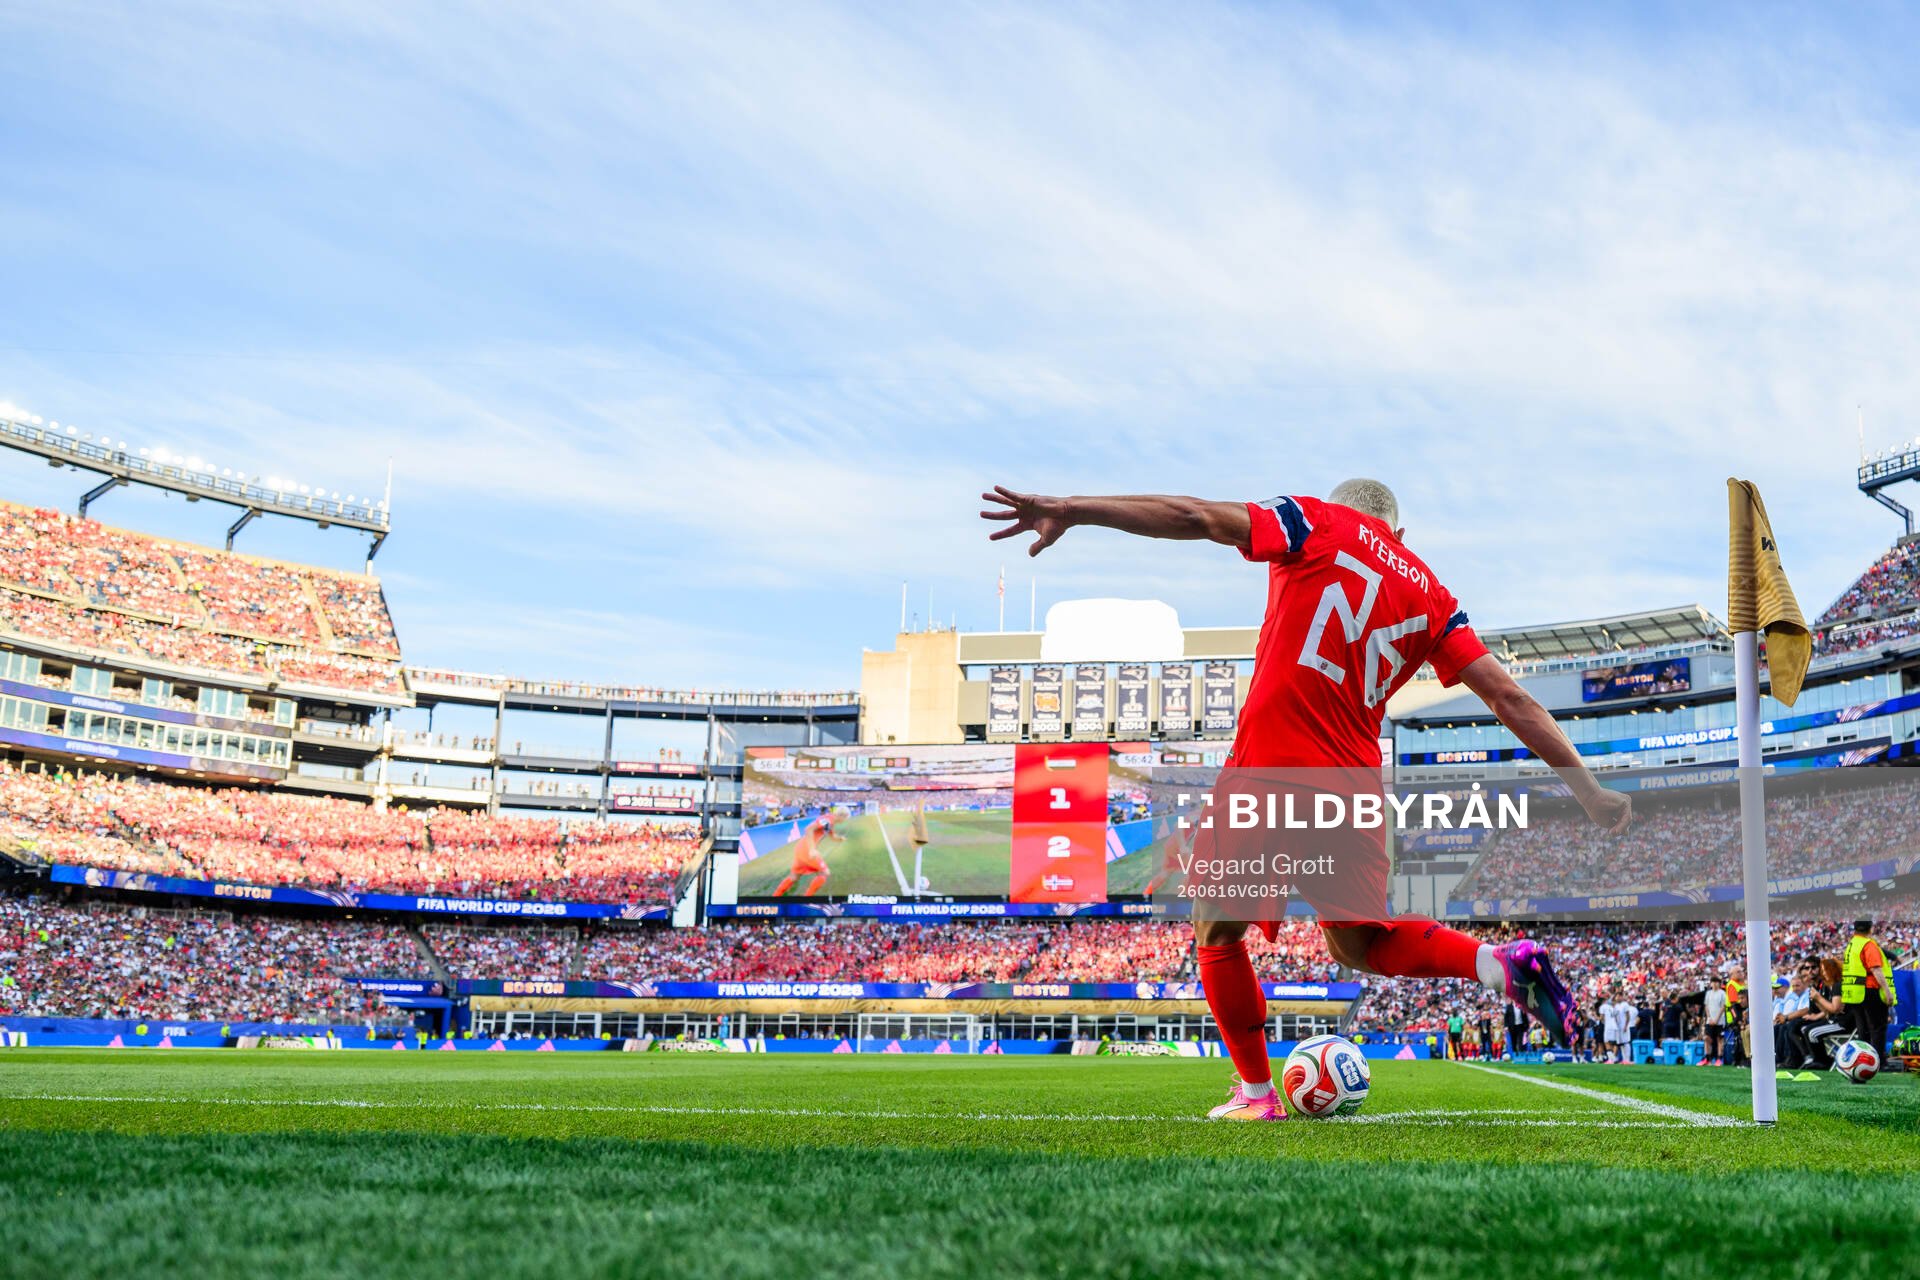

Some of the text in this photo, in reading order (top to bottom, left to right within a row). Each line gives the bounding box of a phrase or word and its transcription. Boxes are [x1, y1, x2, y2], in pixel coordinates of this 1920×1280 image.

[1358, 523, 1430, 594] RYERSON
[1297, 549, 1428, 710] 26
[1615, 673, 1655, 687] BOSTON
[1639, 735, 1666, 749] FIFA
[1665, 730, 1708, 745] WORLD
[1708, 727, 1732, 741] CUP
[1436, 751, 1488, 763] BOSTON
[1640, 775, 1667, 789] FIFA
[1666, 770, 1710, 787] WORLD
[1709, 768, 1733, 782] CUP
[1049, 787, 1071, 809] 1
[1047, 835, 1071, 858] 2
[1426, 834, 1473, 846] BOSTON
[214, 884, 272, 899] BOSTON
[416, 898, 567, 916] FIFA WORLD CUP 2026
[1588, 895, 1638, 908] BOSTON
[736, 906, 779, 915] BOSTON
[891, 904, 1006, 915] FIFA WORLD CUP 2026
[1122, 904, 1166, 914] BOSTON
[503, 981, 565, 994] BOSTON
[718, 983, 864, 996] FIFA WORLD CUP 2026
[1013, 983, 1070, 996] BOSTON
[163, 1026, 187, 1037] FIFA
